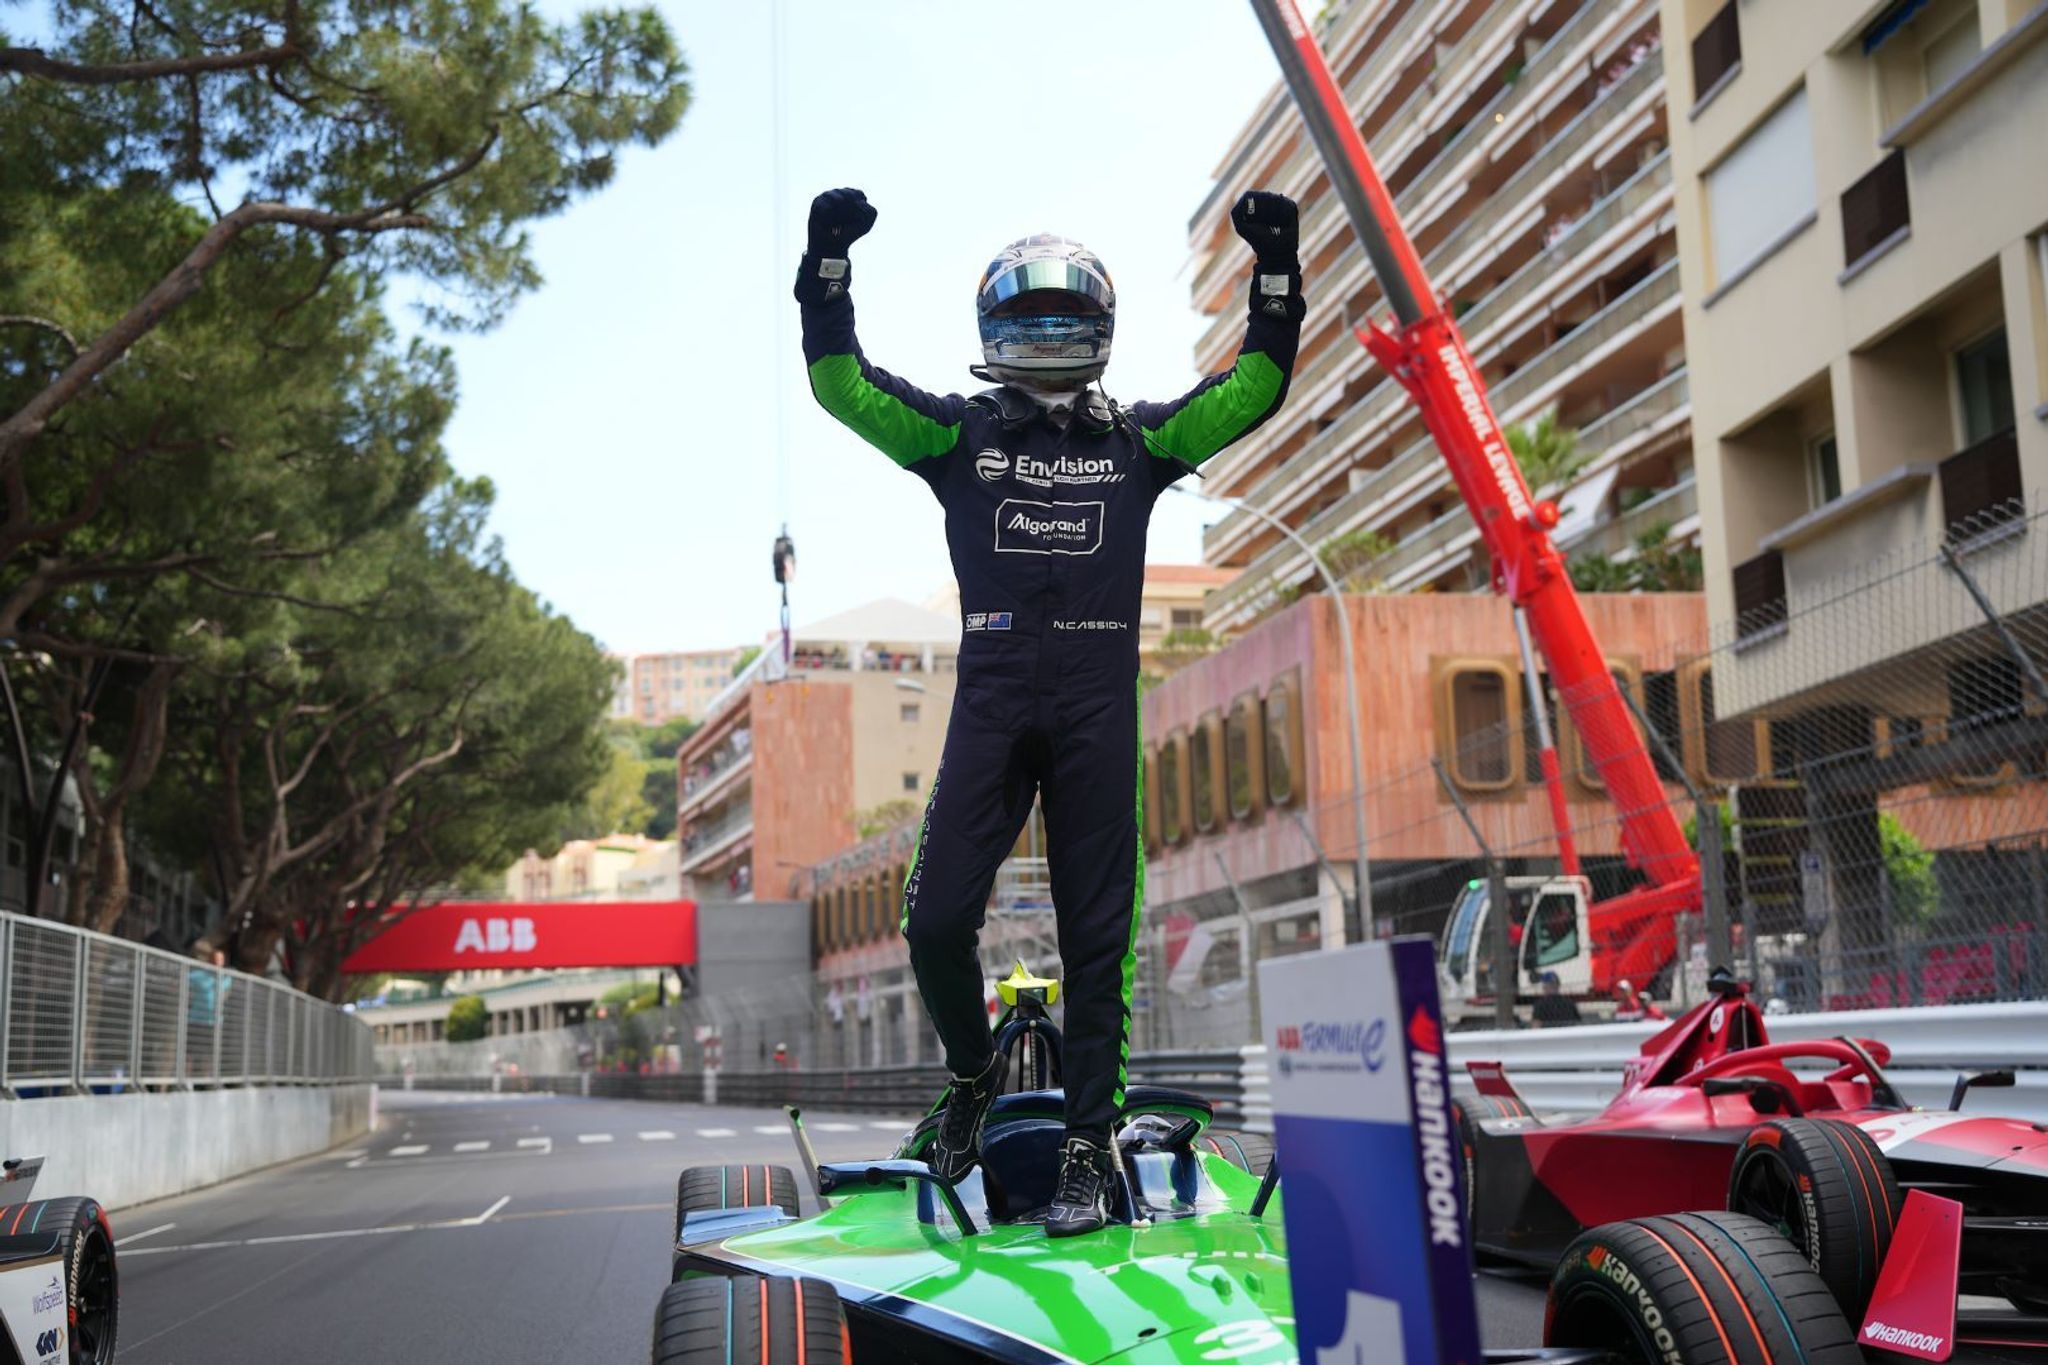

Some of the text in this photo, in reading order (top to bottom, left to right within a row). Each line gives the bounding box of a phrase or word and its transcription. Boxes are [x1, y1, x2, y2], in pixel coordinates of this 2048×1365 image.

[1015, 455, 1114, 478] Envision
[1483, 441, 1531, 521] LEVAGE
[1007, 512, 1086, 535] Algorand
[966, 616, 987, 629] OMP
[454, 917, 538, 954] ABB
